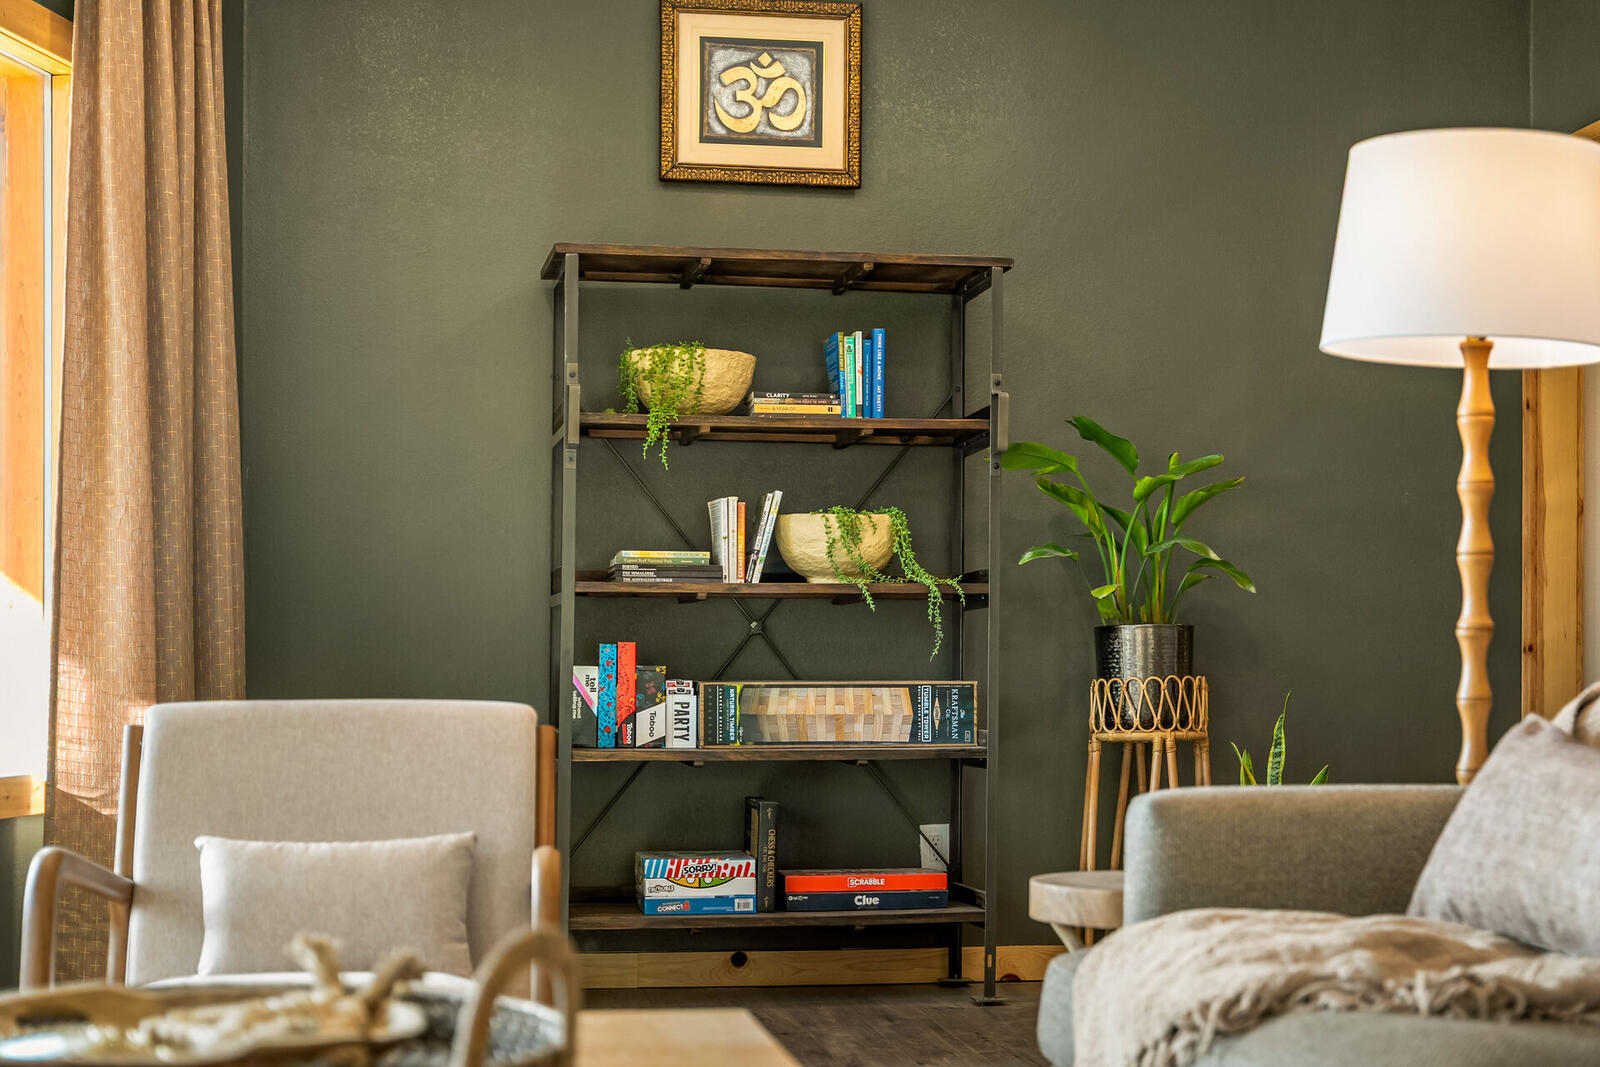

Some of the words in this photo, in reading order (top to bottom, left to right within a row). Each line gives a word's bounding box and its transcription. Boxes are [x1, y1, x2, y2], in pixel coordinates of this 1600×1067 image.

[585, 674, 590, 687] me
[572, 711, 577, 719] me
[951, 688, 959, 739] KRAFTSMAN
[674, 701, 690, 741] PARTY
[768, 828, 776, 850] CHESS
[683, 863, 718, 875] SORRY!
[767, 855, 776, 888] CHECKERS
[848, 877, 885, 887] SCRABBLE
[648, 884, 675, 893] TROUBLE
[657, 902, 684, 912] CONNECT
[683, 900, 691, 910] 4
[854, 894, 880, 906] Clue
